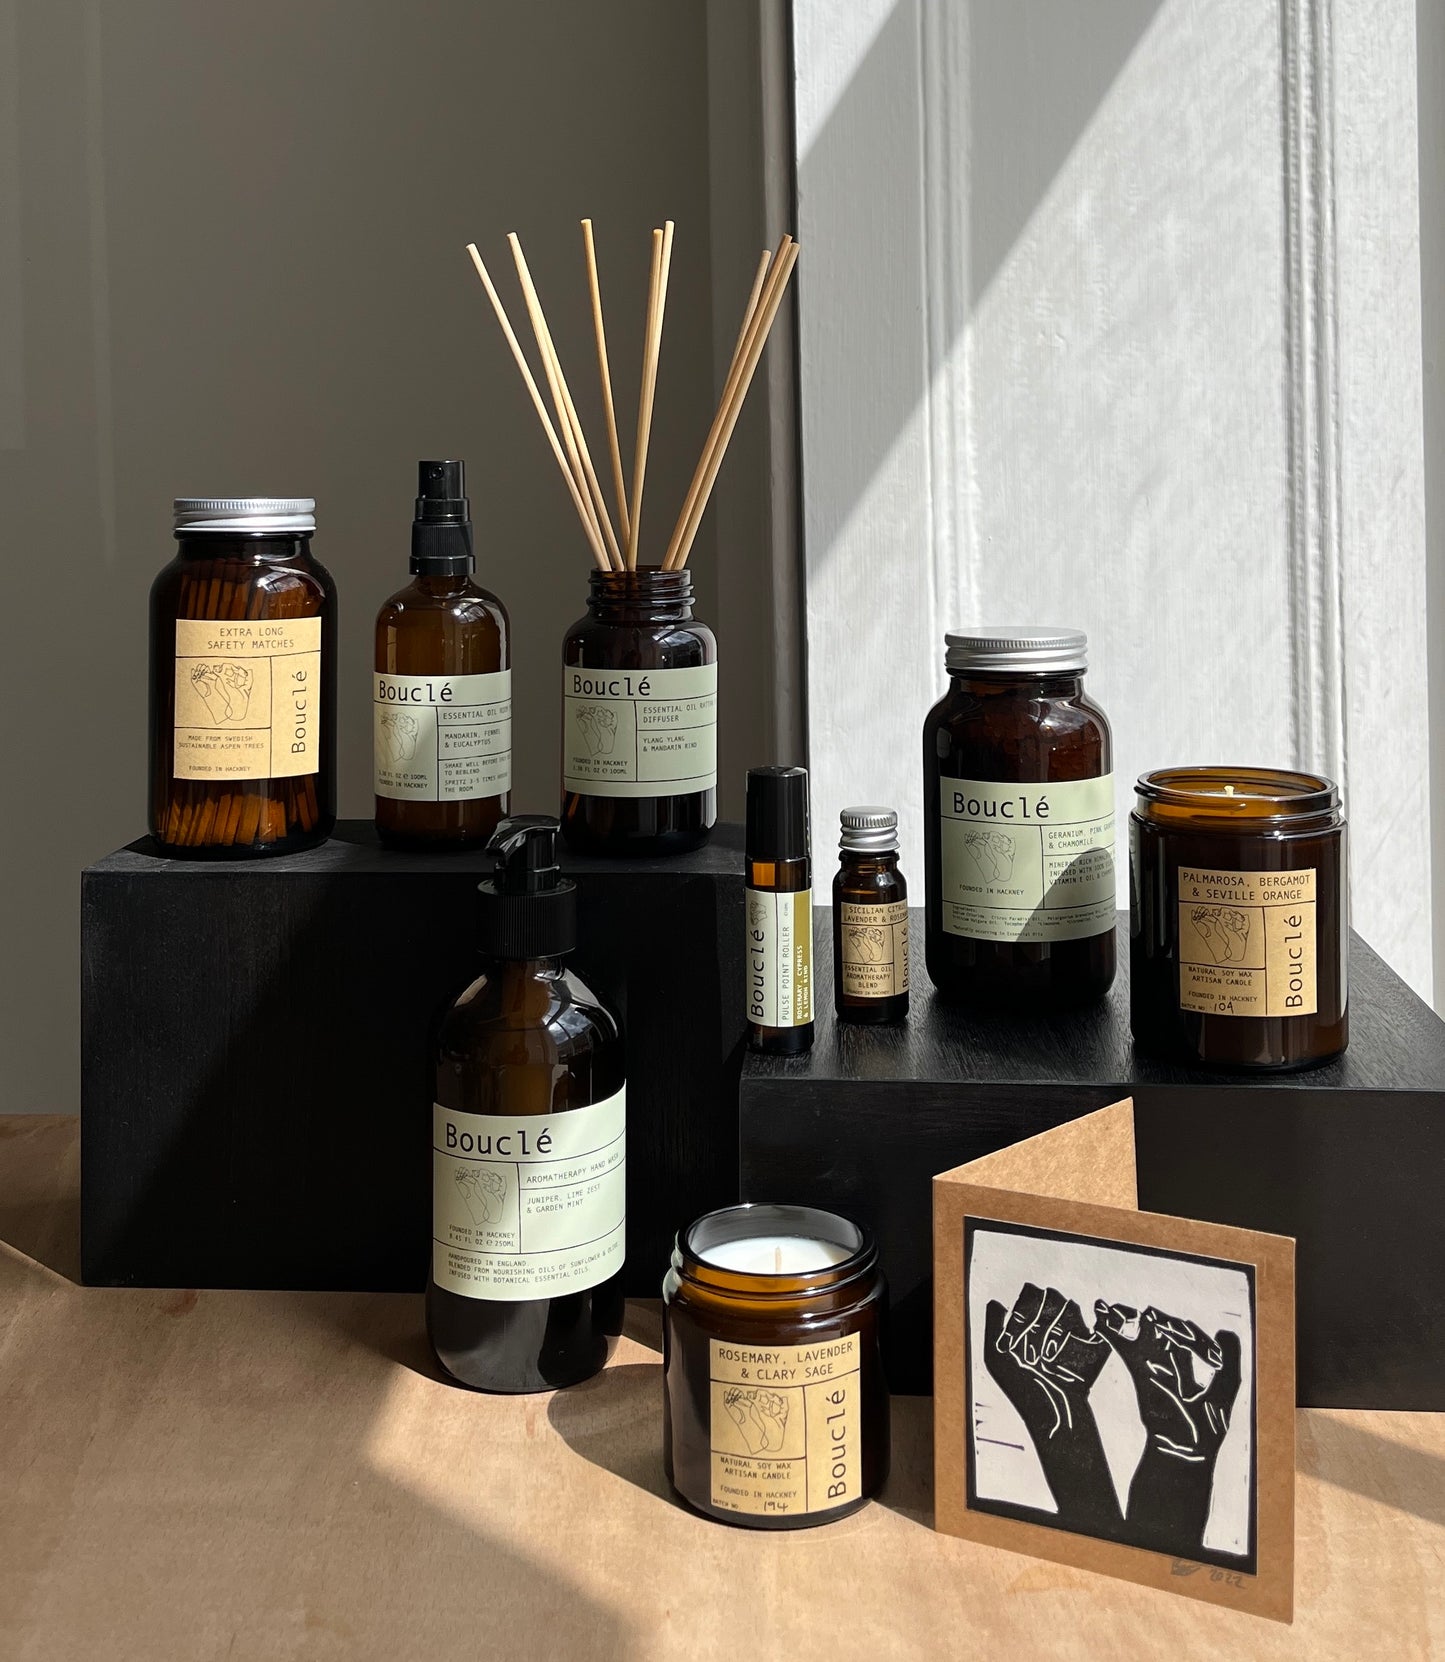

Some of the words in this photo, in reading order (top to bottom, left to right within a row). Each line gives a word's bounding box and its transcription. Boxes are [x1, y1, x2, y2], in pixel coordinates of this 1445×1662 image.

[220, 628, 251, 637] EXTRA
[258, 627, 284, 636] LONG
[207, 640, 246, 650] SAFETY
[252, 640, 294, 649] MATCHES
[379, 680, 453, 702] Bouclé
[573, 674, 651, 696] Bouclé
[291, 670, 308, 754] Bouclé
[442, 710, 484, 720] ESSENTIAL
[486, 708, 496, 716] OIL
[643, 706, 683, 714] ESSENTIAL
[643, 714, 680, 724] DIFFUSER
[444, 732, 480, 740] MANDARIN,
[454, 738, 491, 748] EUCALYPTUS
[954, 792, 1050, 818] Bouclé
[1058, 837, 1094, 848] CHAMOMILE
[1079, 858, 1092, 866] RICH
[1050, 869, 1076, 877] INFUSED
[1079, 866, 1092, 874] WITH
[1049, 877, 1077, 885] VITAMIN
[1183, 872, 1250, 888] PALMAROSA,
[1259, 874, 1311, 887] BERGAMOT
[959, 884, 983, 893] FOUNDED
[986, 886, 994, 894] IN
[997, 886, 1025, 896] HACKNEY
[1192, 888, 1200, 897] &
[1206, 889, 1255, 900] SEVILLE
[1263, 889, 1302, 900] ORANGE
[849, 906, 884, 914] SICILIAN
[844, 915, 878, 923] LAVENDER
[782, 926, 790, 958] ROLLER
[1283, 914, 1303, 1008] Bouclé
[750, 929, 764, 1018] Bouclé
[845, 965, 877, 973] ESSENTIAL
[1188, 966, 1217, 976] NATURAL
[782, 964, 790, 989] POINT
[1192, 975, 1222, 984] ARTISAN
[1189, 991, 1214, 1000] FOUNDED
[782, 994, 790, 1020] PULSE
[446, 1122, 553, 1156] Bouclé
[527, 1167, 587, 1184] AROMATHERAPY
[590, 1161, 606, 1172] HAND
[527, 1195, 562, 1205] JUNIPER,
[567, 1189, 583, 1199] LIME
[587, 1183, 601, 1194] ZEST
[536, 1204, 564, 1213] GARDEN
[567, 1199, 584, 1208] MINT
[449, 1224, 472, 1235] FOUNDED
[448, 1253, 482, 1265] HANDPOURED
[448, 1261, 471, 1272] BLENDED
[539, 1266, 555, 1274] OILS
[570, 1253, 601, 1267] SUNFLOWER
[449, 1269, 471, 1280] INFUSED
[493, 1276, 530, 1284] BOTANICAL
[535, 1270, 571, 1283] ESSENTIAL
[718, 1348, 786, 1365] ROSEMARY,
[797, 1342, 853, 1363] LAVENDER
[741, 1368, 750, 1378] &
[757, 1369, 796, 1380] CLARY
[805, 1363, 834, 1378] SAGE
[826, 1389, 847, 1499] Bouclé
[720, 1456, 752, 1468] NATURAL
[757, 1462, 772, 1470] SOY
[776, 1462, 792, 1470] WAX
[724, 1467, 758, 1479] ARTISAN
[762, 1472, 791, 1480] CANDLE
[720, 1485, 749, 1497] FOUNDED
[764, 1501, 788, 1512] 194
